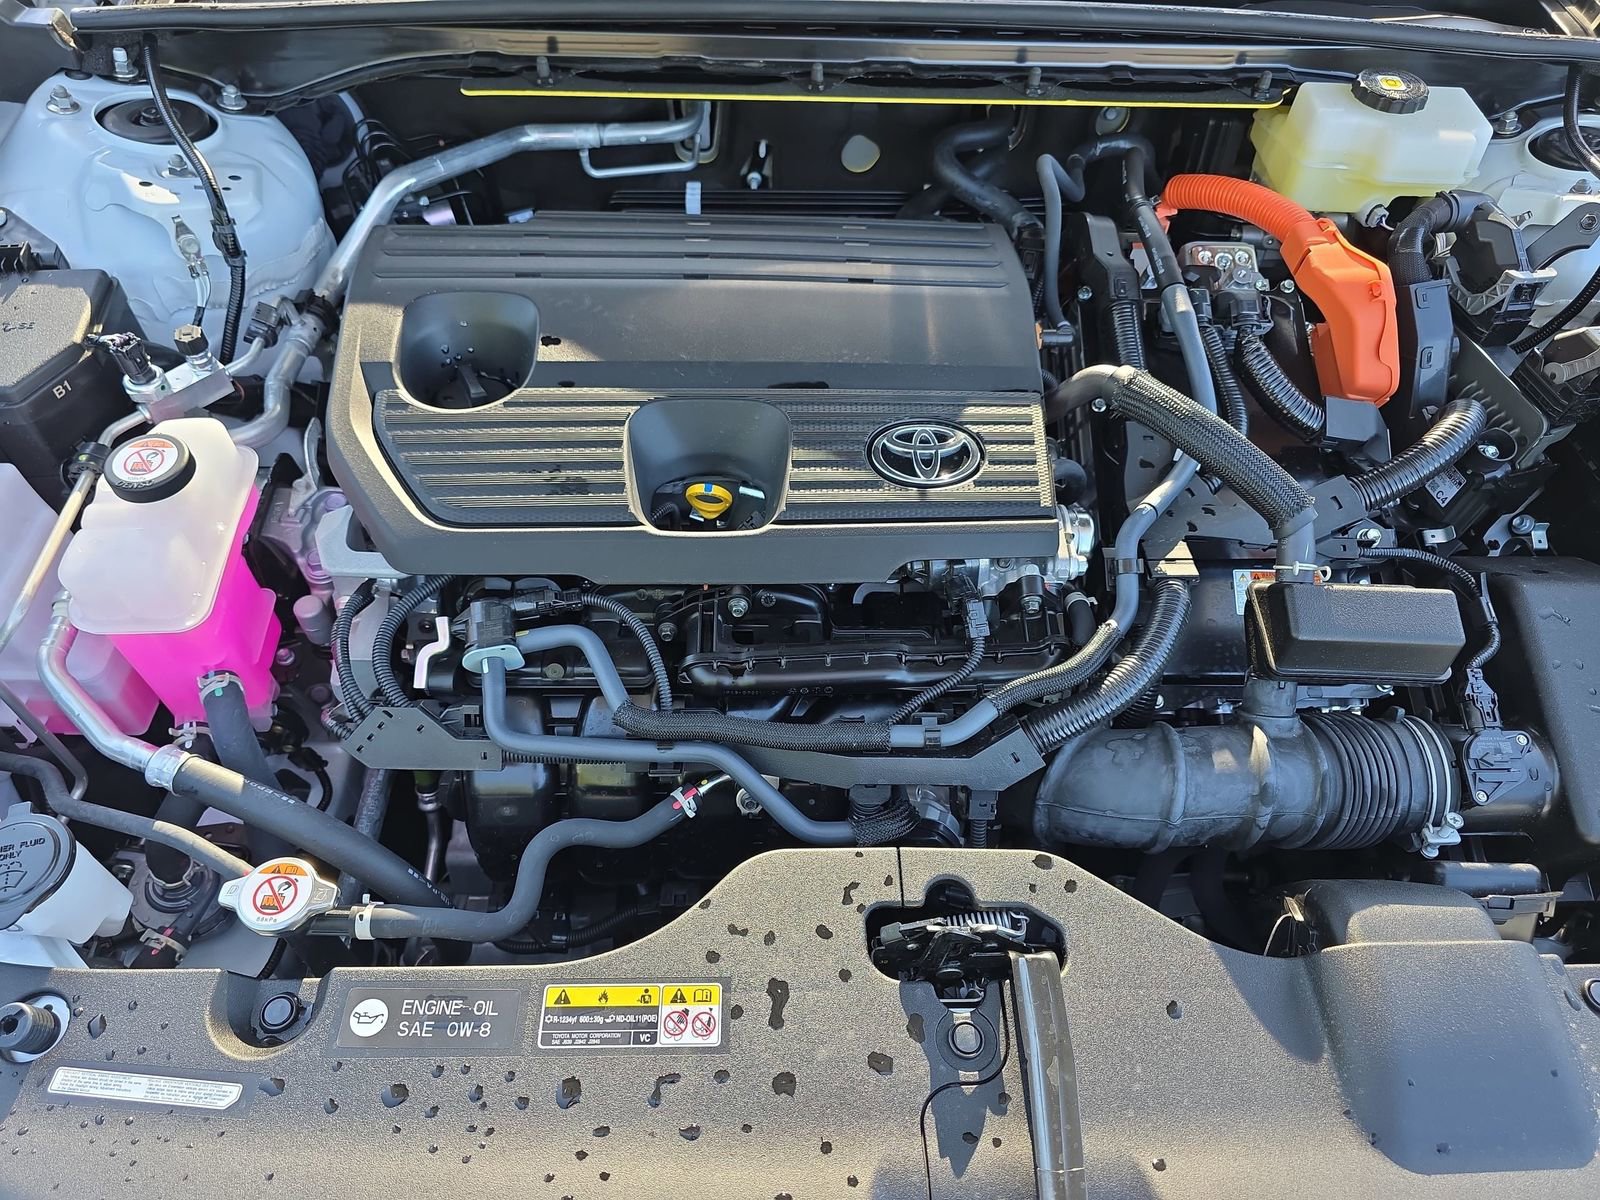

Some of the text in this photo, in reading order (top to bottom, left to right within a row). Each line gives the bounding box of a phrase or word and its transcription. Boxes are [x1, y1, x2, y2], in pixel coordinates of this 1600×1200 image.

[52, 380, 72, 399] B1
[1436, 490, 1448, 504] C4
[20, 837, 46, 848] FLUID
[0, 849, 22, 861] ONLY
[401, 1000, 498, 1016] ENGINE OIL
[552, 1015, 578, 1025] R-1234yf
[397, 1021, 491, 1038] SAE 0W-8
[639, 1033, 651, 1042] VC
